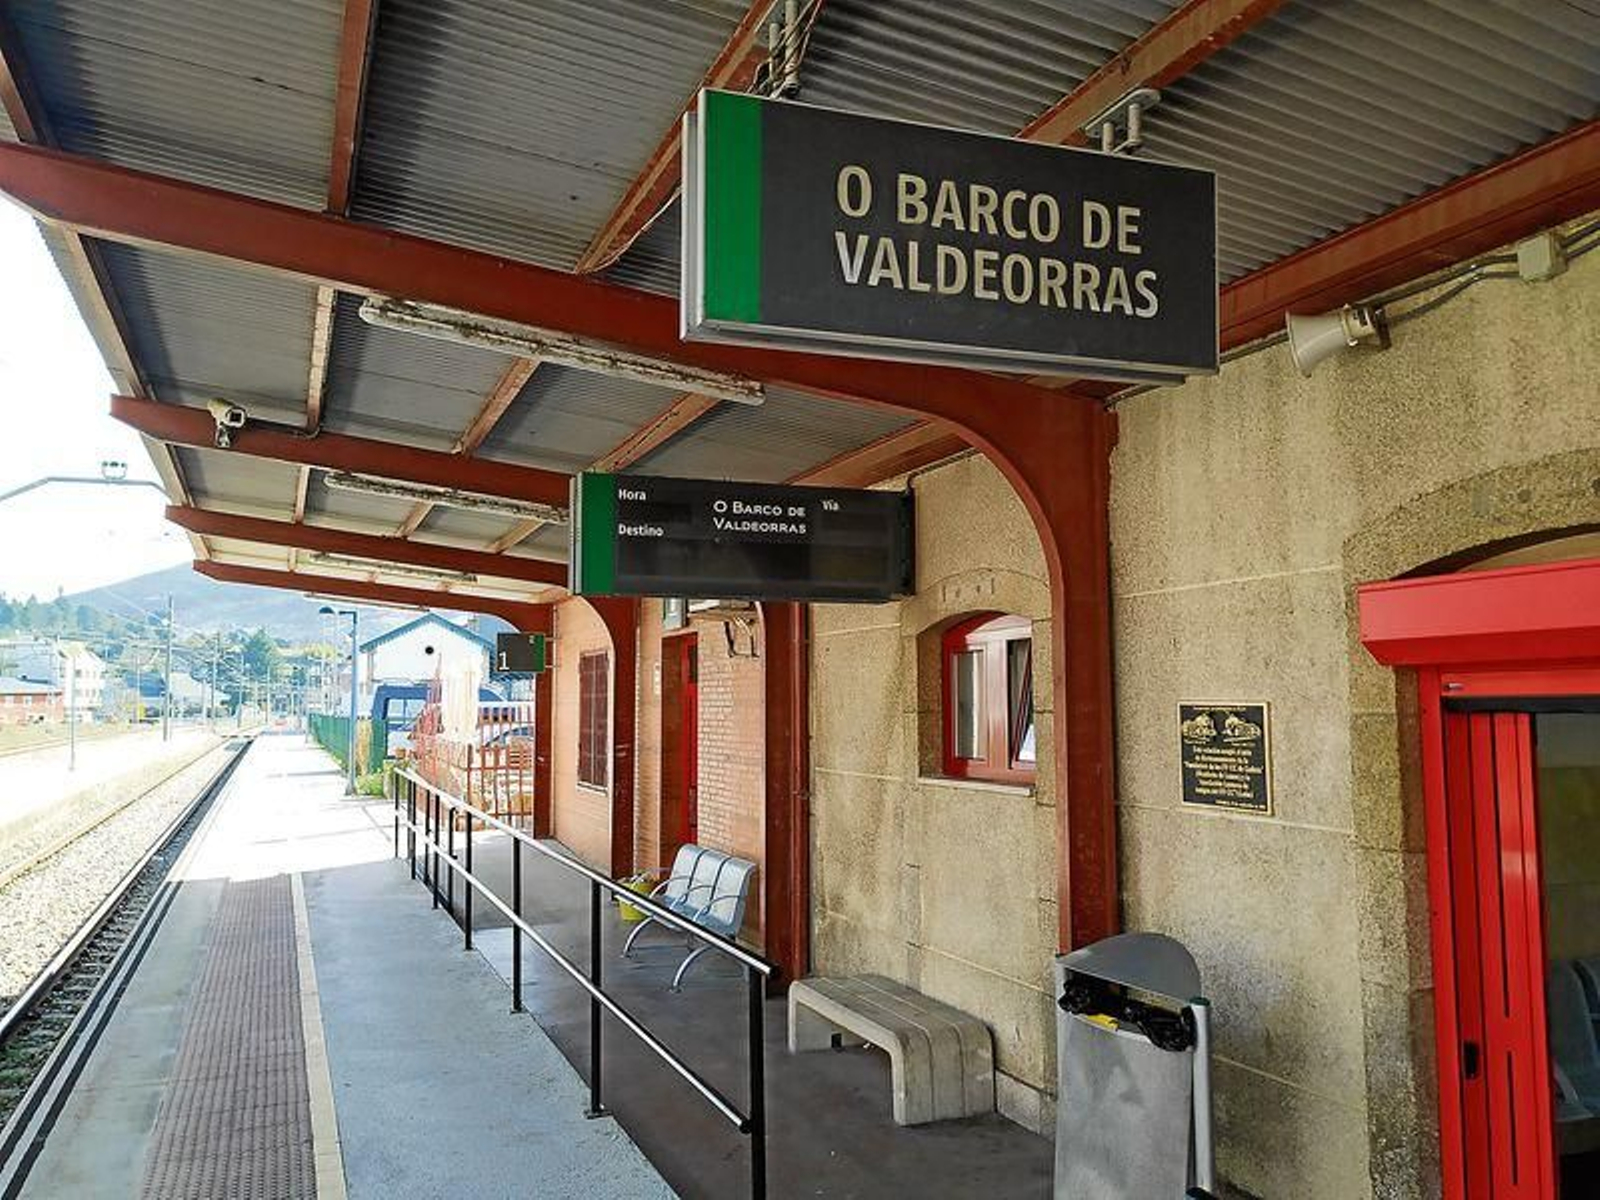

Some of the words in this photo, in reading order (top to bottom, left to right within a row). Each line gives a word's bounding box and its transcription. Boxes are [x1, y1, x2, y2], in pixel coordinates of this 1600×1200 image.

[836, 165, 873, 218] O
[897, 173, 1060, 243] BARCO
[1082, 200, 1142, 254] DE
[834, 231, 1160, 319] VALDEORRAS
[618, 488, 648, 501] Hora
[713, 500, 728, 513] O
[618, 523, 664, 537] Destino
[713, 517, 807, 535] VALDEORRAS
[498, 651, 510, 671] 1
